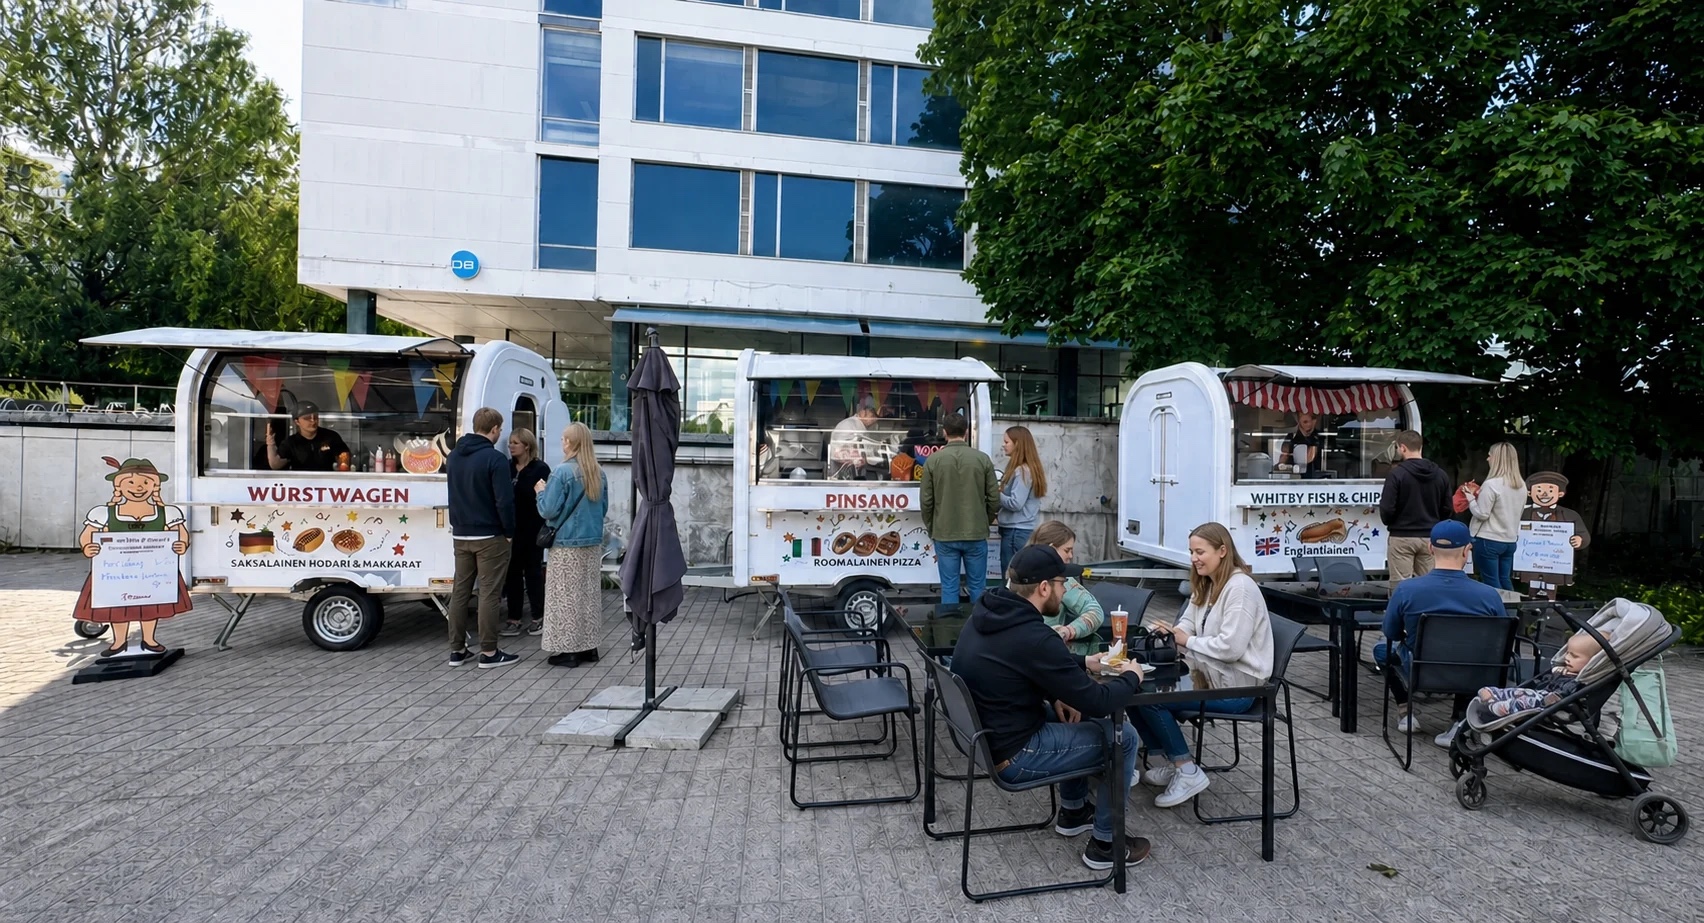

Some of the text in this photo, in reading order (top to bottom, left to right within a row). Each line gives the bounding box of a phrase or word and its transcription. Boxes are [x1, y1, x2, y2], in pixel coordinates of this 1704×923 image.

[248, 483, 409, 503] WÜRSTWAGEN
[1251, 493, 1304, 504] WHITBY
[1308, 492, 1336, 503] FISH
[1338, 492, 1350, 503] &
[825, 494, 909, 509] PINSANO
[231, 559, 422, 570] SAKSALAINEN HODARI & MAKKARAT
[814, 558, 922, 567] ROOMALAINEN PIZZA
